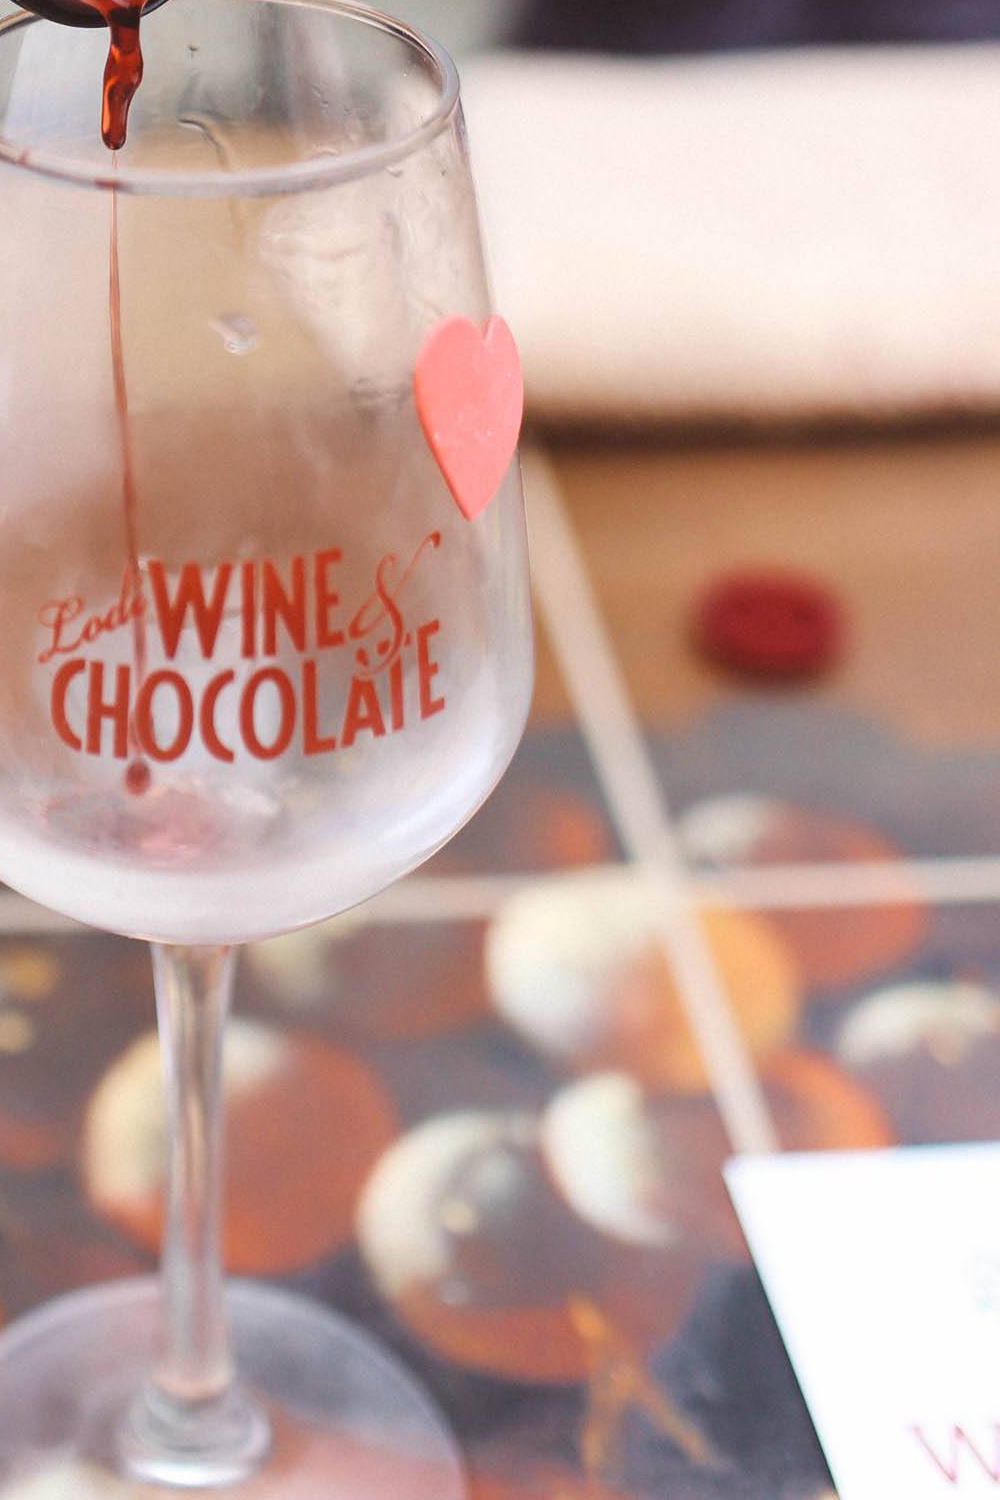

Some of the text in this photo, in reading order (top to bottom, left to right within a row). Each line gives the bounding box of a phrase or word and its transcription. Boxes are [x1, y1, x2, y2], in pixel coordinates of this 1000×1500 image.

[149, 548, 345, 660] WINE
[348, 532, 441, 678] &
[51, 620, 446, 763] CHOCOLATE
